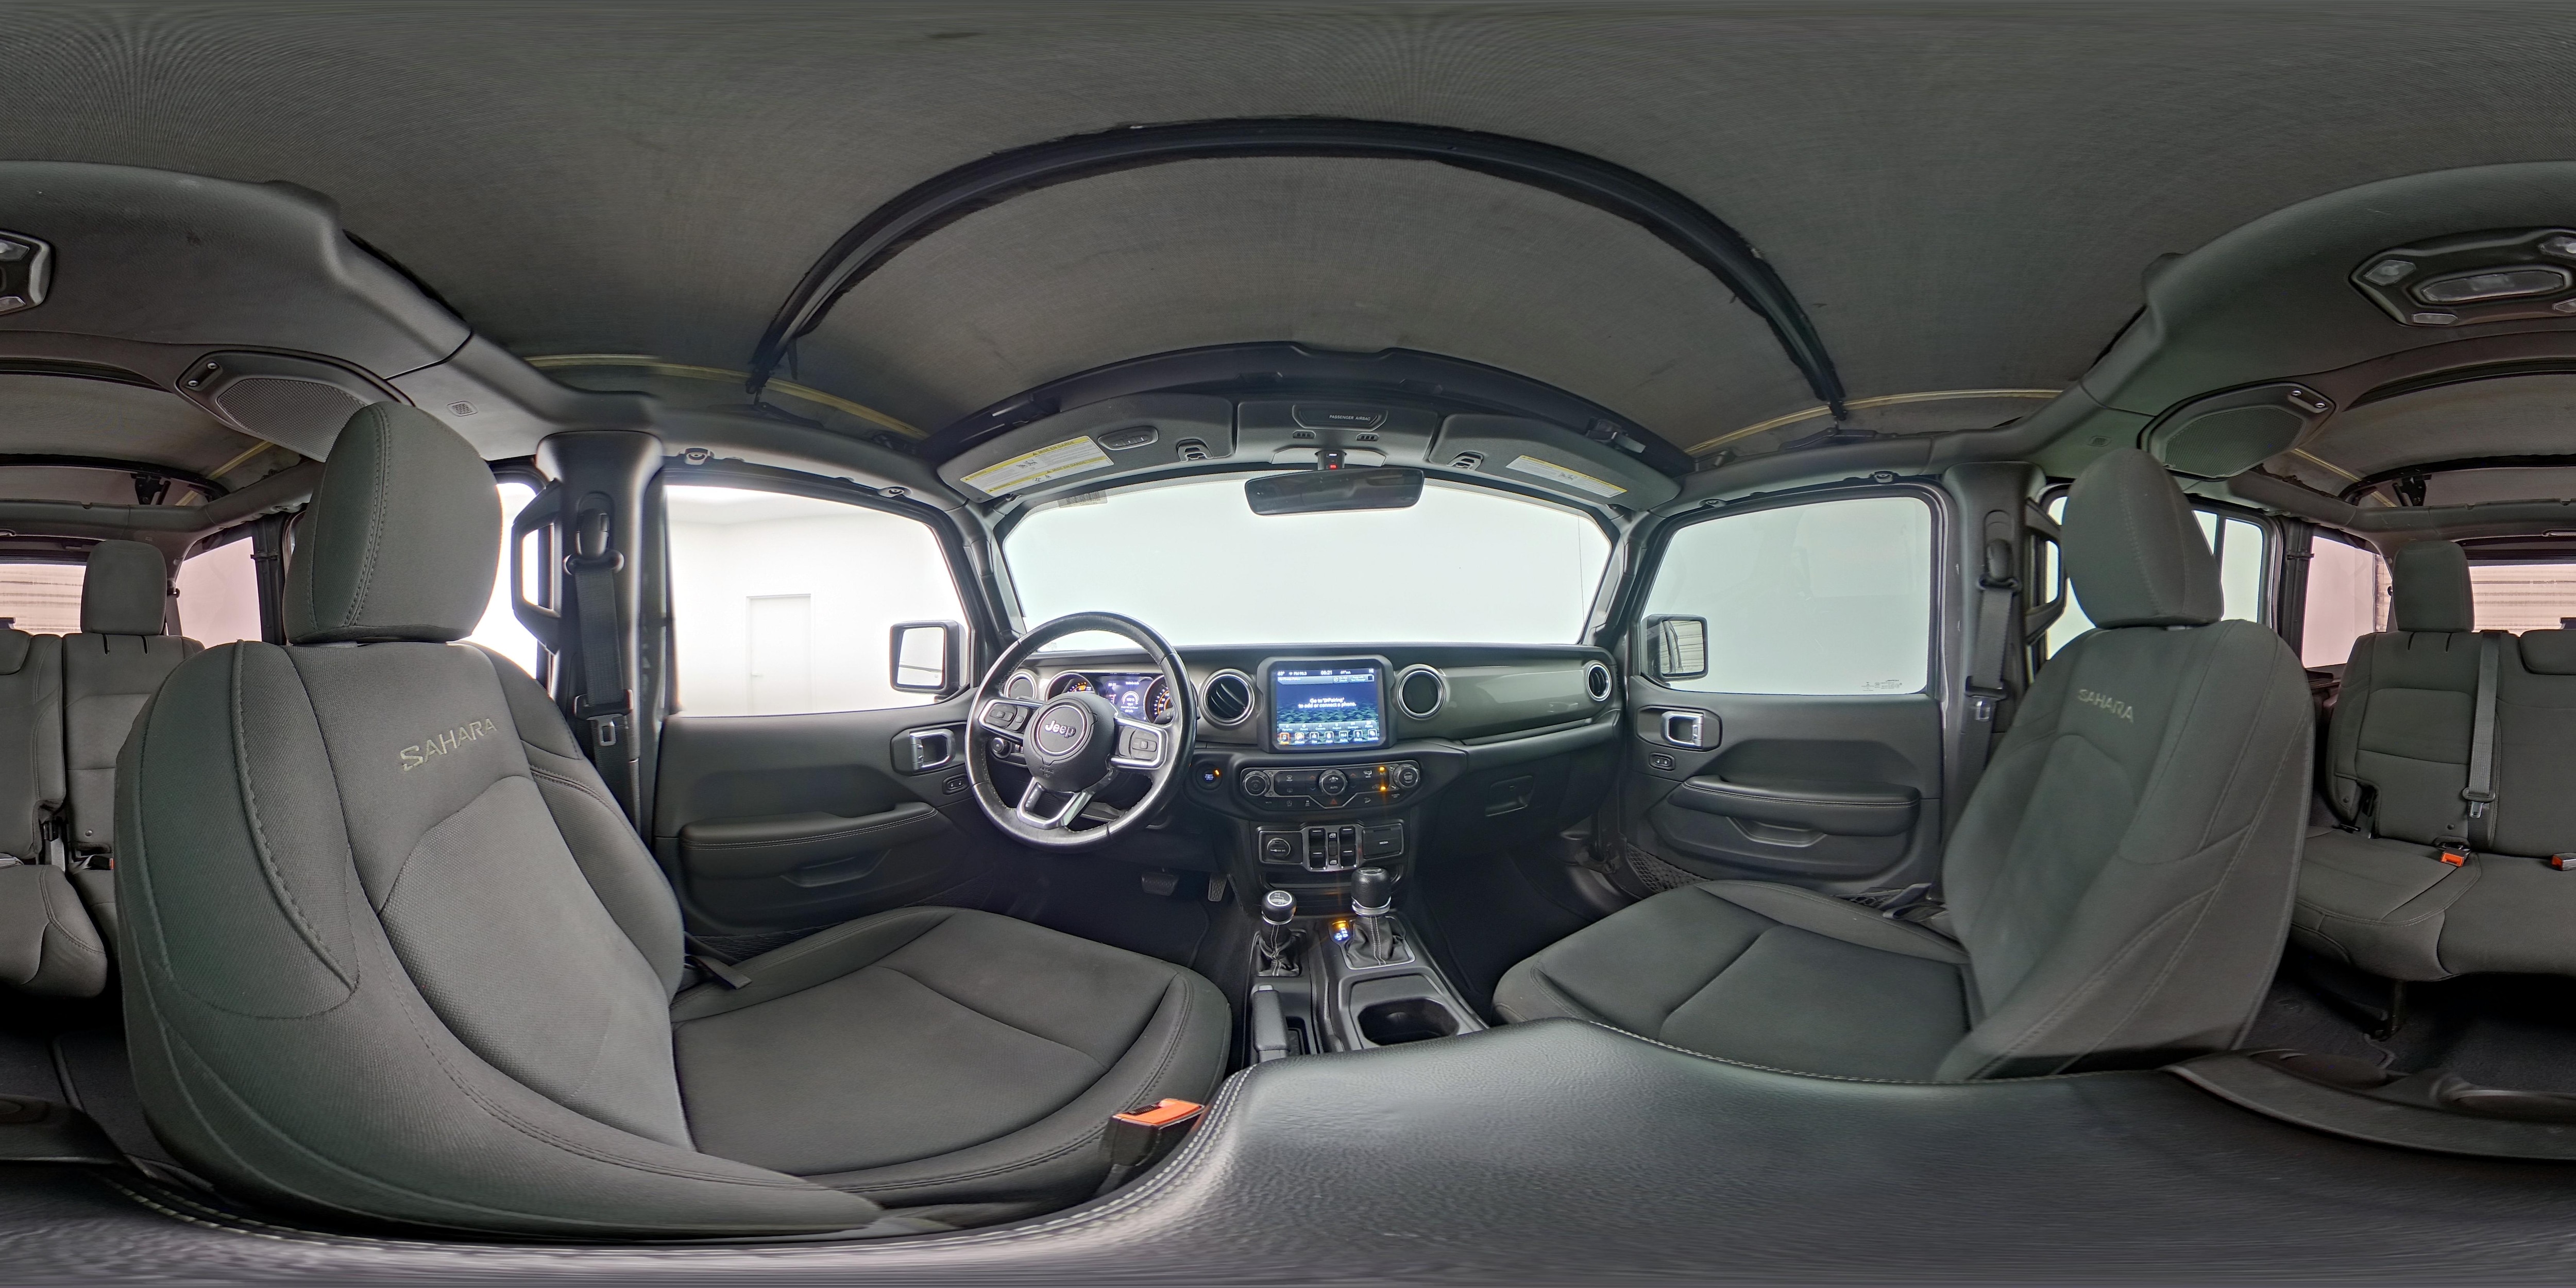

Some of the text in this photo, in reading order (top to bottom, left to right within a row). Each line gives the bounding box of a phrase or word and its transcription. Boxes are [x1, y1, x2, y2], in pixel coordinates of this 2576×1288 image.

[2078, 689, 2134, 723] SAHARA
[400, 718, 498, 772] SAHARA
[1044, 719, 1076, 739] Jeep
